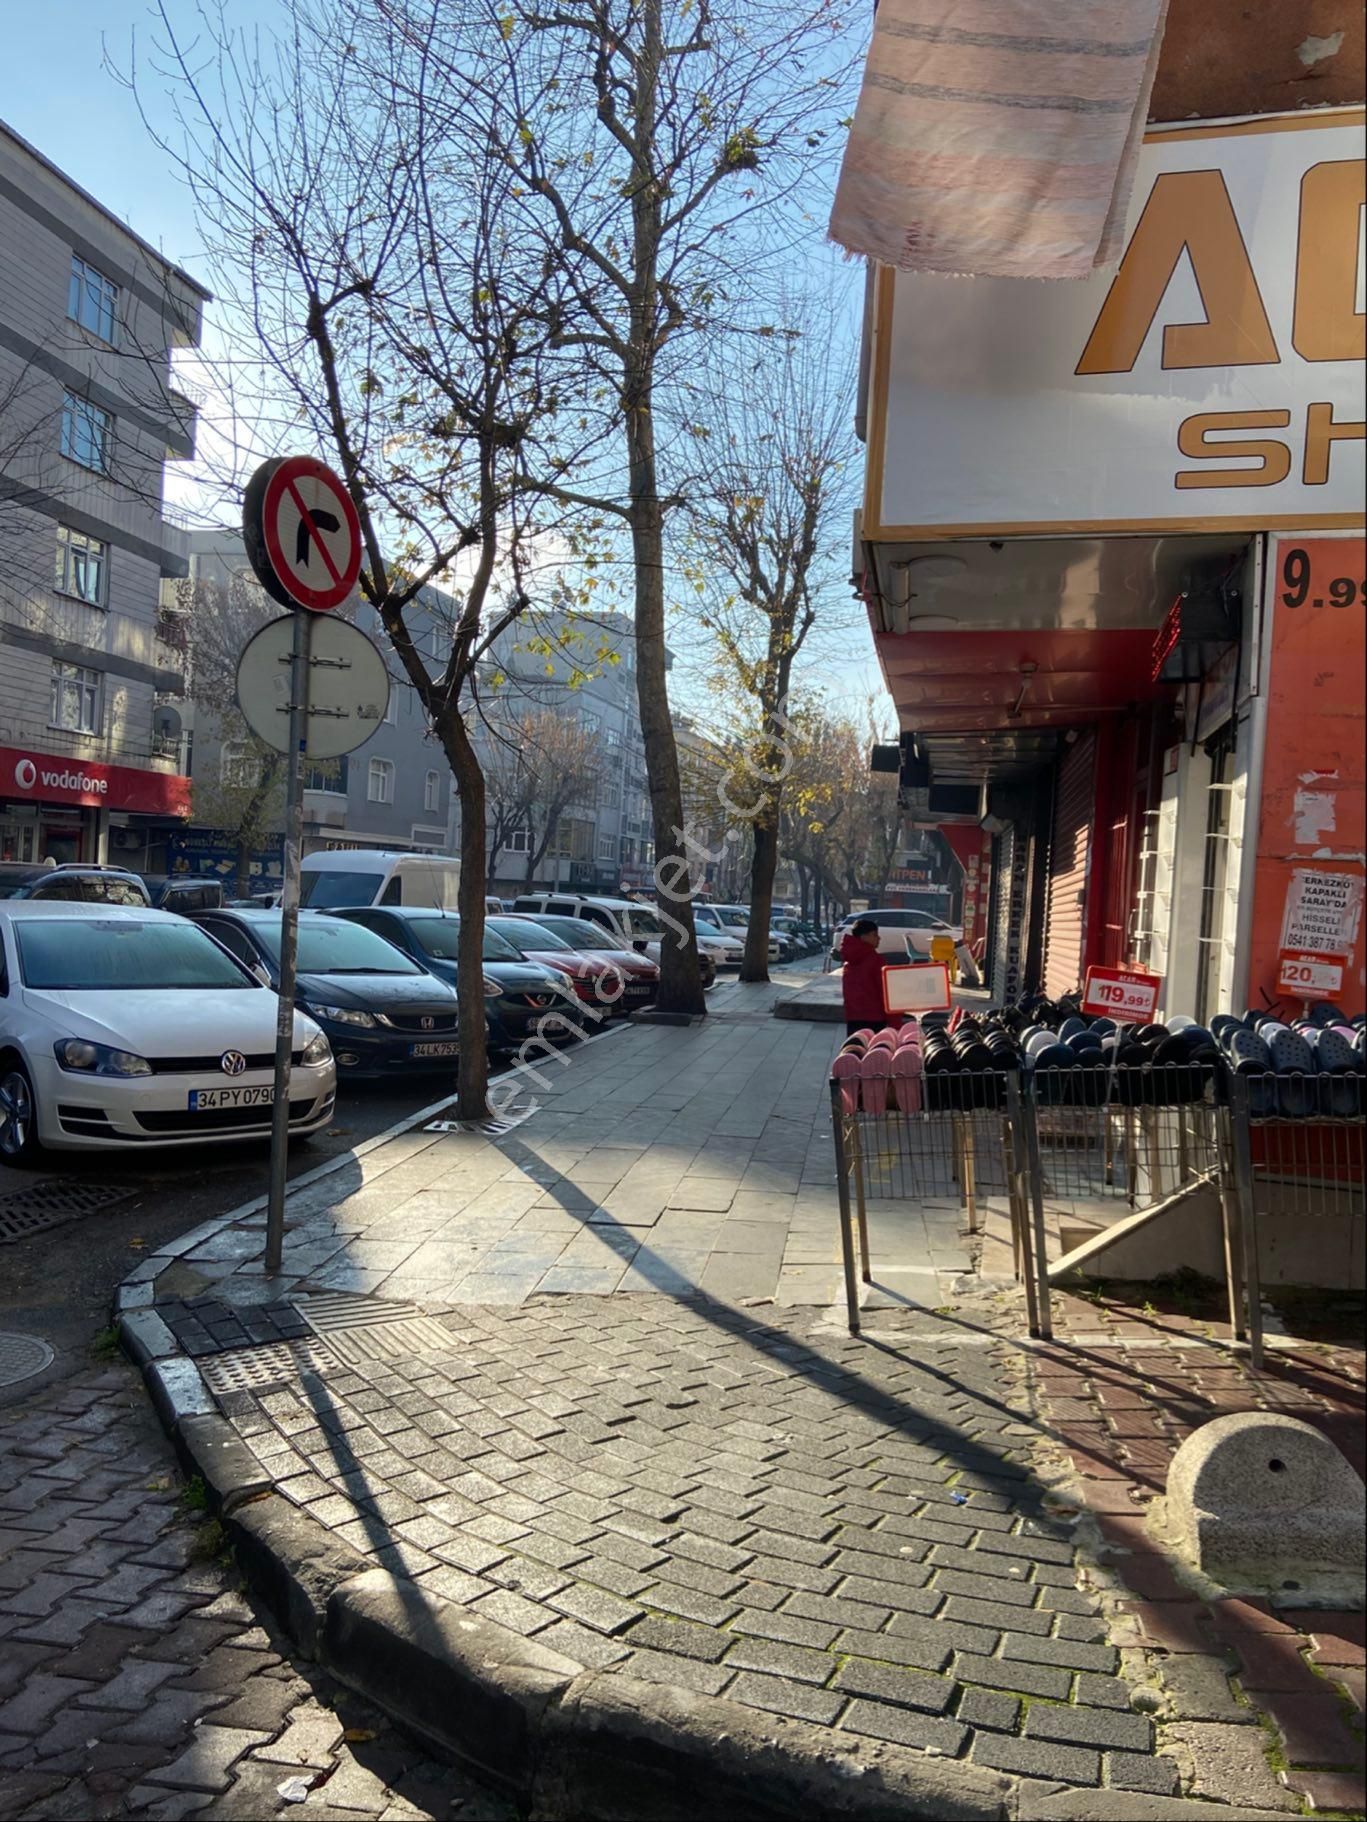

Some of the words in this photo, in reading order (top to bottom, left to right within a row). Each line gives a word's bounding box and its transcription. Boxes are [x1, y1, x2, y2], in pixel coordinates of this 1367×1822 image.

[1282, 548, 1366, 608] 9.9
[40, 769, 108, 794] vodafone
[1304, 886, 1346, 898] KAPAKLI
[1291, 922, 1346, 936] PARSELLE
[198, 1091, 217, 1108] 34
[219, 1089, 242, 1107] PY
